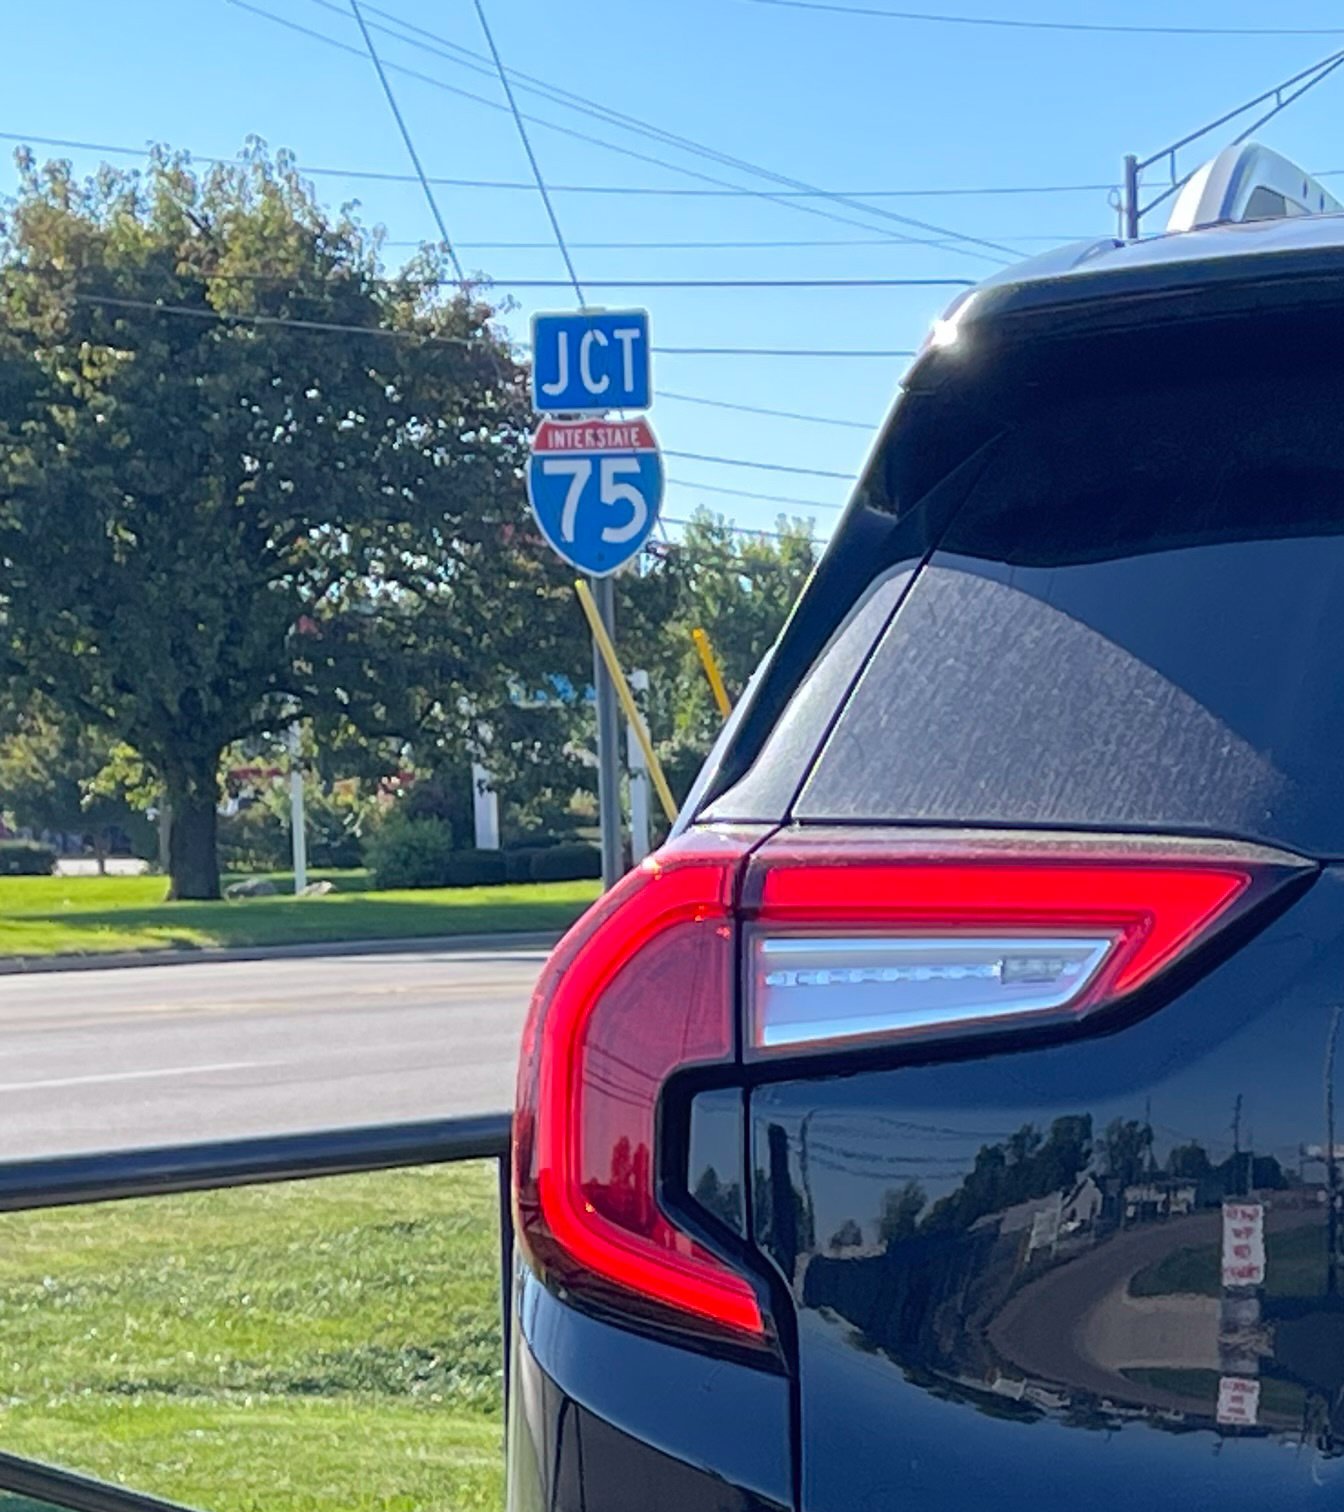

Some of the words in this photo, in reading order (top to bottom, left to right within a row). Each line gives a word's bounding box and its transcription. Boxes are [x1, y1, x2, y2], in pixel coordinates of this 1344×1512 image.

[542, 328, 641, 396] JCT
[547, 427, 641, 448] INTERSTATE
[543, 458, 647, 544] 75
